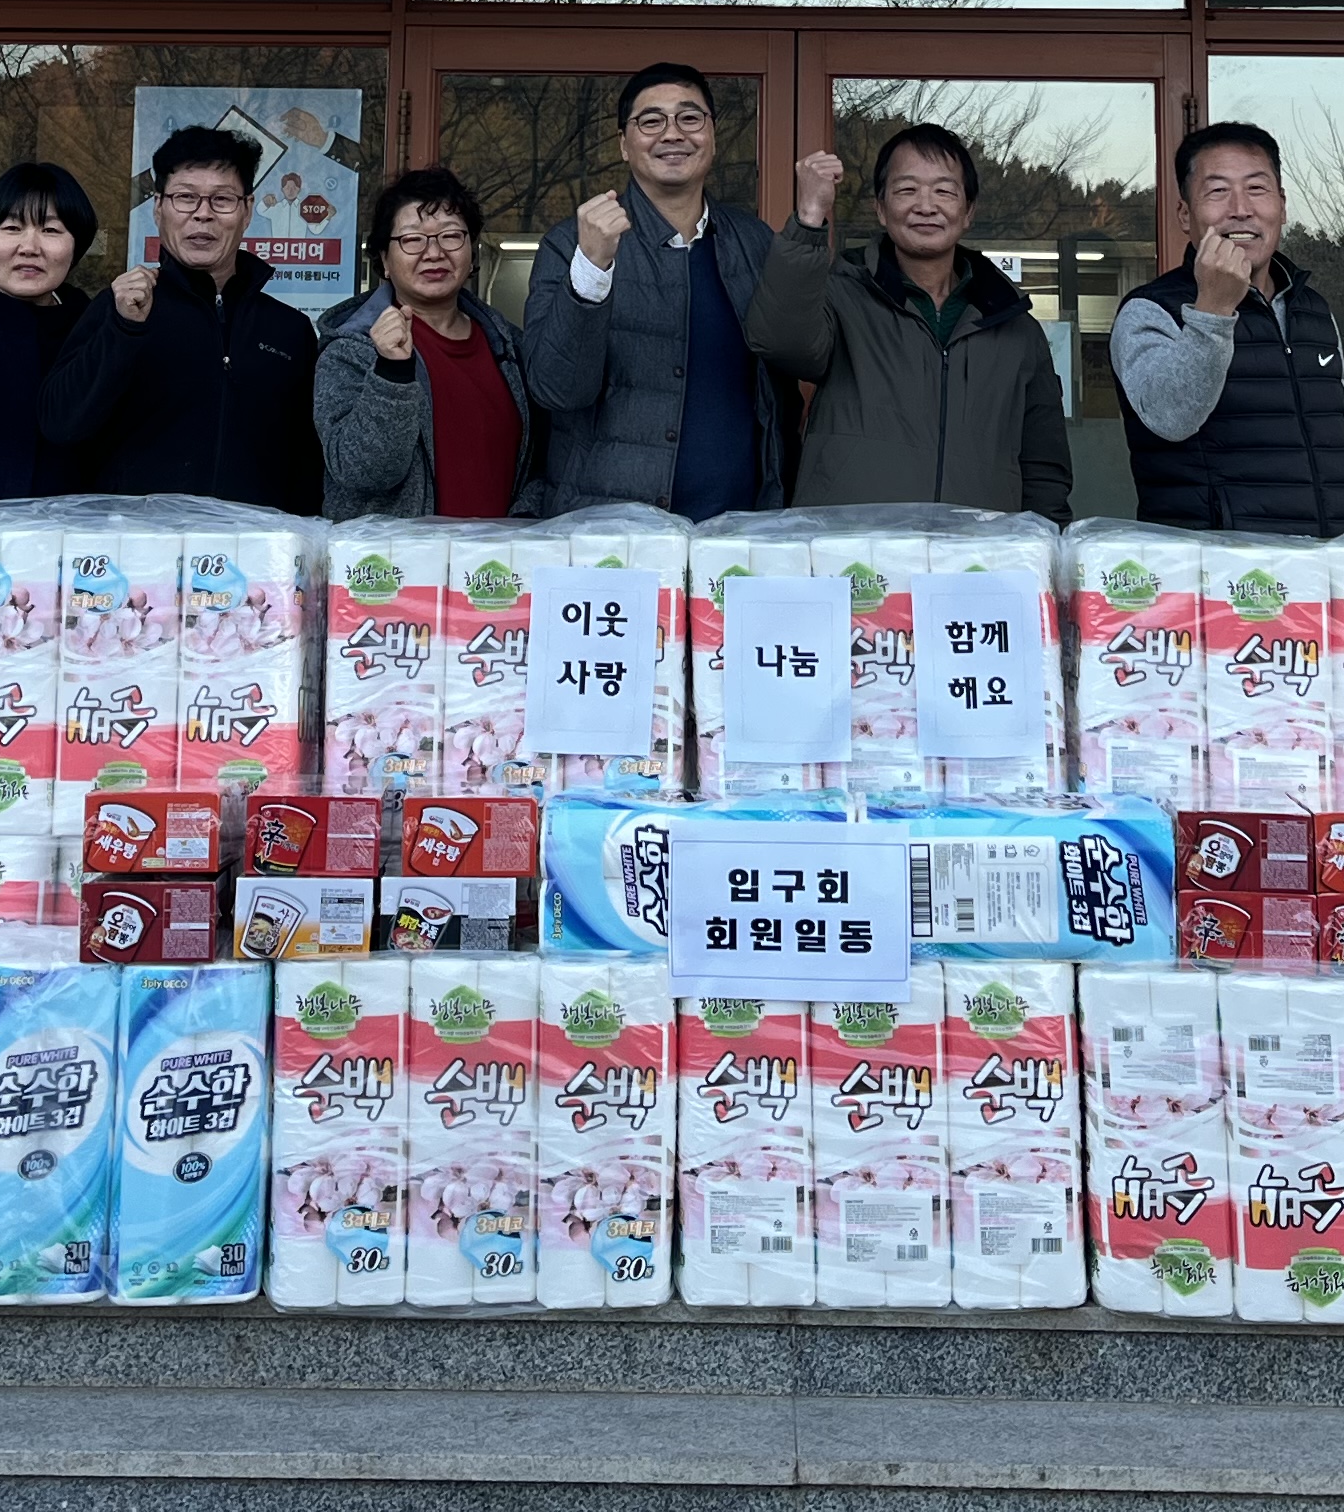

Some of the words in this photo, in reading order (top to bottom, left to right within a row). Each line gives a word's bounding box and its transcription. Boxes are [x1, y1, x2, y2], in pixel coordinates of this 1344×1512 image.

[302, 205, 326, 214] STOP
[255, 241, 324, 261] 명의대여
[345, 566, 405, 588] 행복나무
[464, 570, 524, 595] 행복나무
[1101, 571, 1161, 593] 행복나무
[1228, 579, 1288, 602] 행복나무
[561, 601, 629, 638] 이웃
[340, 617, 431, 680] 순백
[944, 620, 1009, 654] 함께
[755, 644, 820, 678] 나눔
[1099, 624, 1191, 687] 순백
[1226, 634, 1318, 697] 순백
[556, 659, 627, 697] 사랑
[947, 676, 1013, 710] 해요
[622, 845, 634, 883] WHITE
[1060, 842, 1085, 896] 화이트
[1126, 854, 1139, 885] PURE
[627, 883, 639, 917] PURE
[728, 868, 849, 904] 입구회
[1080, 834, 1134, 946] 순수한
[553, 892, 562, 918] DECO
[1132, 888, 1147, 925] WHITE
[10, 975, 35, 985] DECO
[142, 978, 162, 990] 3ply
[164, 979, 188, 988] DECO
[296, 993, 362, 1020] 행복나무
[429, 998, 496, 1023] 행복나무
[560, 1002, 626, 1028] 행복나무
[834, 1003, 899, 1028] 행복나무
[964, 994, 1029, 1019] 행복나무
[7, 1053, 38, 1068] PURE
[40, 1046, 79, 1064] WHITE
[161, 1056, 192, 1072] PURE
[194, 1050, 231, 1068] WHITE
[140, 1063, 250, 1117] 순수한
[294, 1054, 393, 1123] 순백
[424, 1057, 525, 1129] 순백
[556, 1063, 656, 1132] 순백
[697, 1051, 797, 1123] 순백
[832, 1059, 932, 1133] 순백
[963, 1054, 1063, 1124] 순백
[49, 1105, 83, 1131] 3겹
[146, 1114, 202, 1140] 화이트
[203, 1107, 238, 1133] 3겹
[25, 1159, 51, 1172] 100%
[179, 1161, 207, 1174] 100%
[66, 1242, 89, 1259] 30
[222, 1244, 245, 1261] 30
[65, 1260, 89, 1274] Roll
[221, 1262, 244, 1277] Roll
